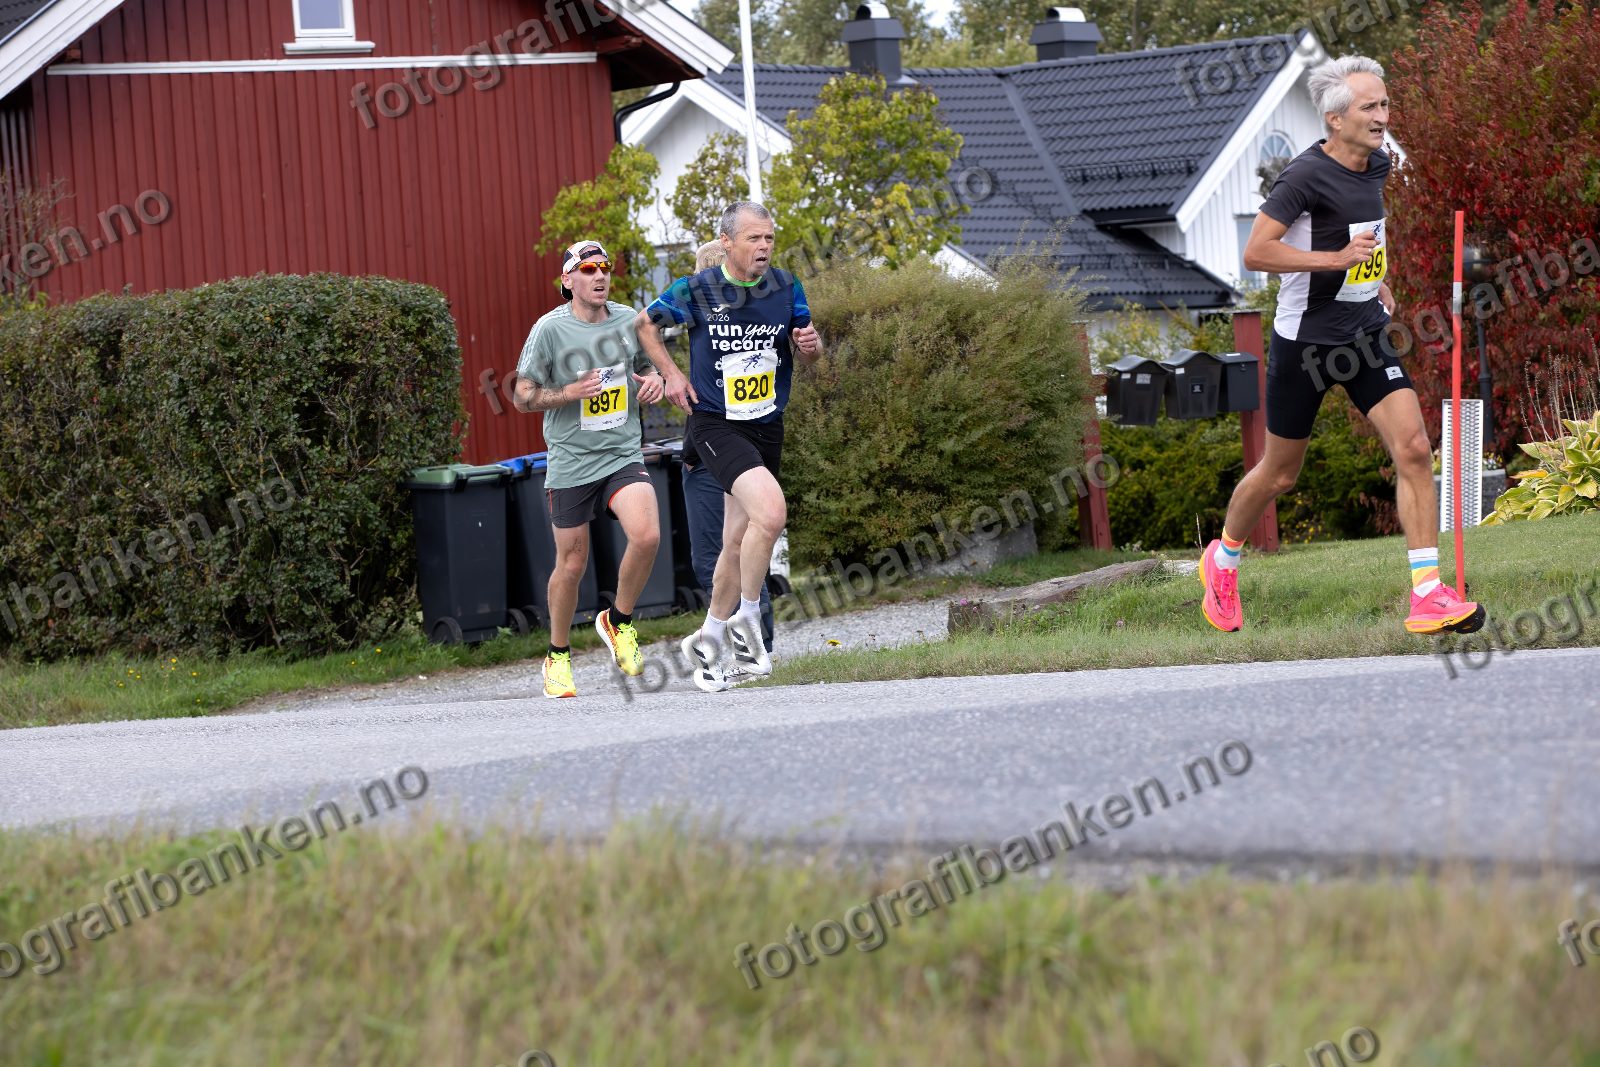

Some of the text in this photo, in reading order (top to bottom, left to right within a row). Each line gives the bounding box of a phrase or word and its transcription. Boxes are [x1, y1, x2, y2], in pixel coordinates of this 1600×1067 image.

[708, 323, 785, 343] run your
[711, 336, 775, 351] record
[734, 374, 769, 401] 820
[589, 388, 621, 414] 897
